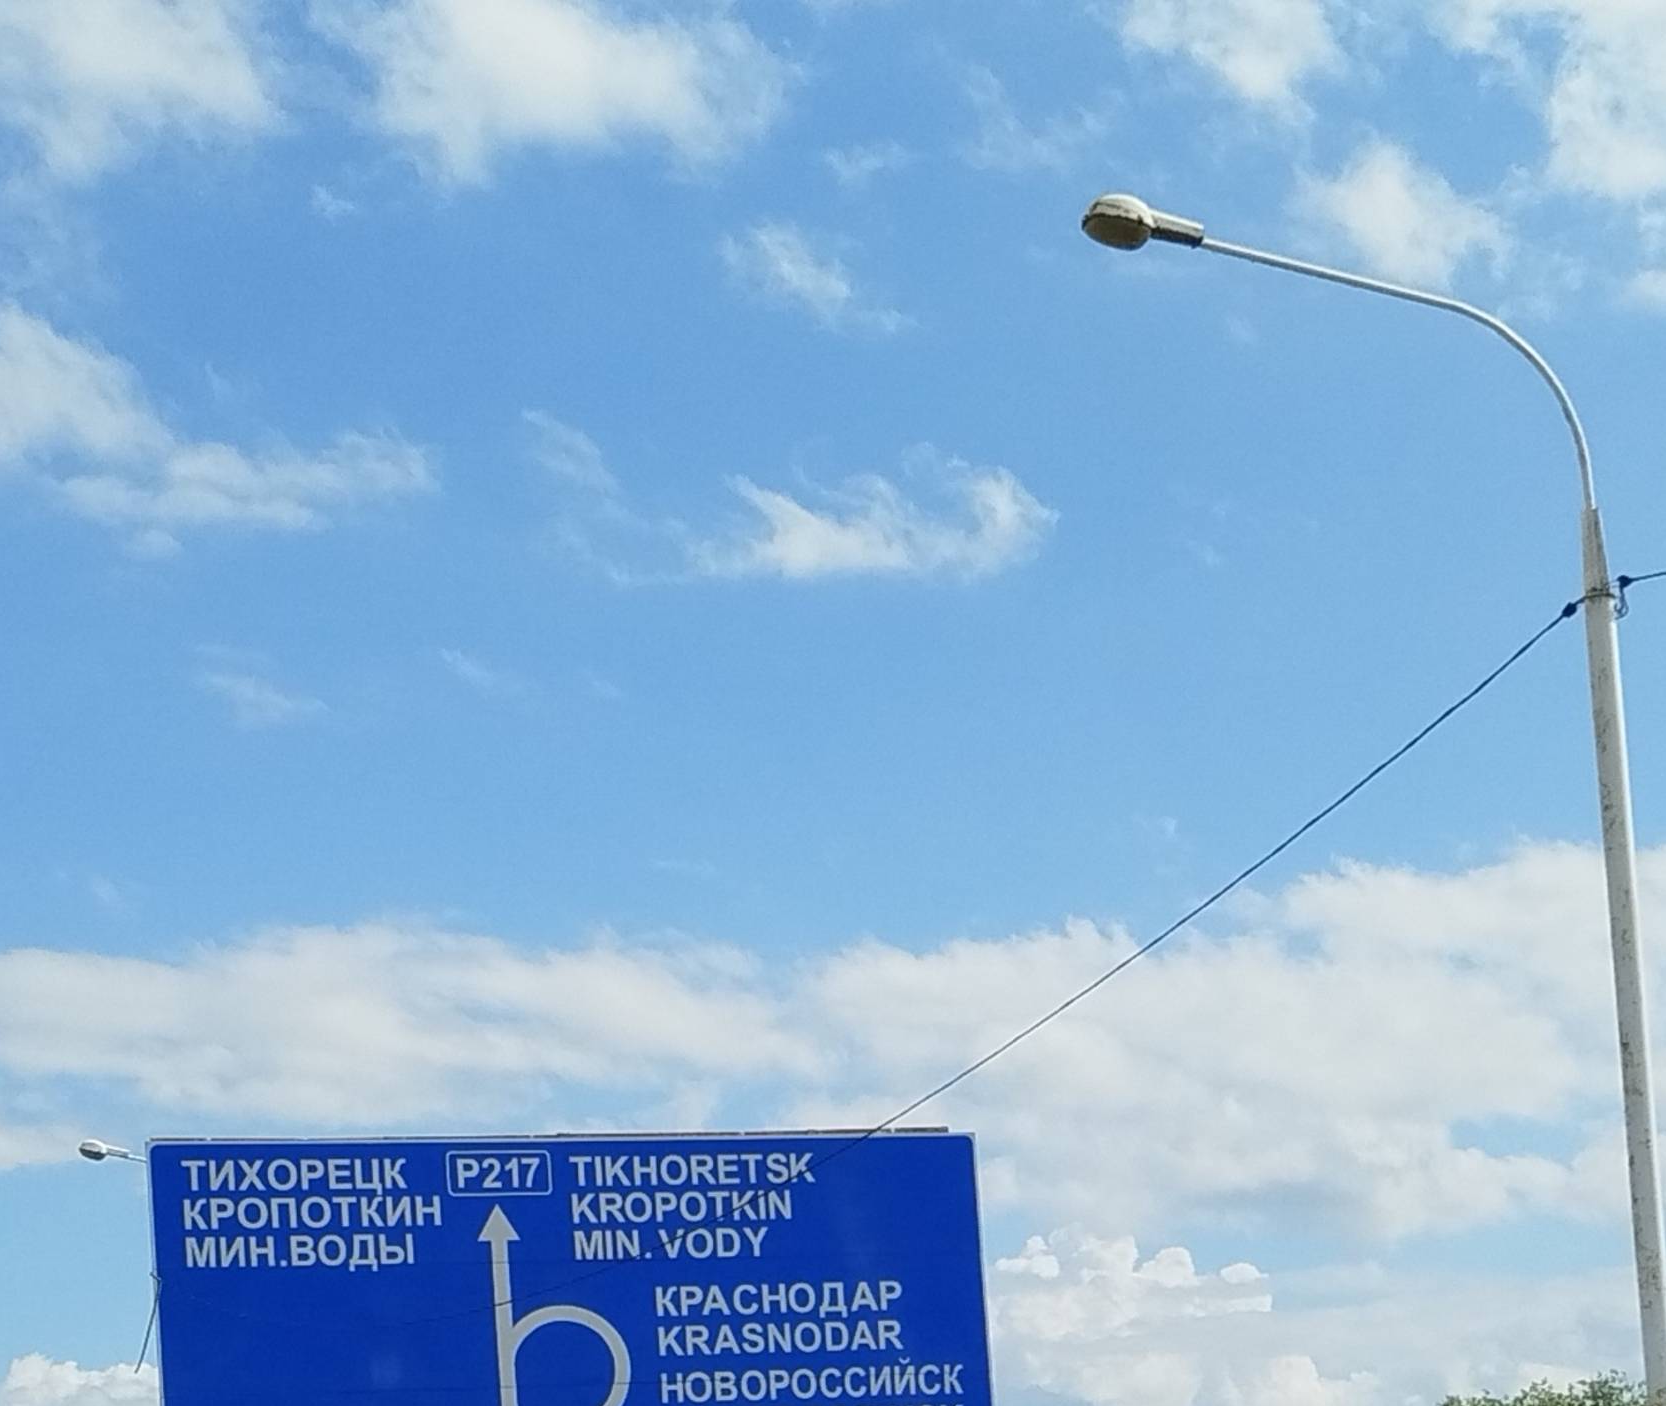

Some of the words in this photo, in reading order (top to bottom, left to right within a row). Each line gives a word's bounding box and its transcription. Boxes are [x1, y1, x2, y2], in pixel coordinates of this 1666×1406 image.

[181, 1158, 407, 1196] ТИХОРЕЦК
[569, 1153, 815, 1186] TIKHORETSK
[183, 1195, 442, 1230] КРОПОТКИН
[571, 1190, 792, 1224] KROPOTKIN
[573, 1229, 652, 1260] MIN.
[660, 1227, 768, 1259] VODY
[655, 1281, 902, 1318] КРАСНОДАР
[658, 1320, 903, 1356] KRASNODAR
[661, 1357, 963, 1403] НОВОРОССИЙСК
